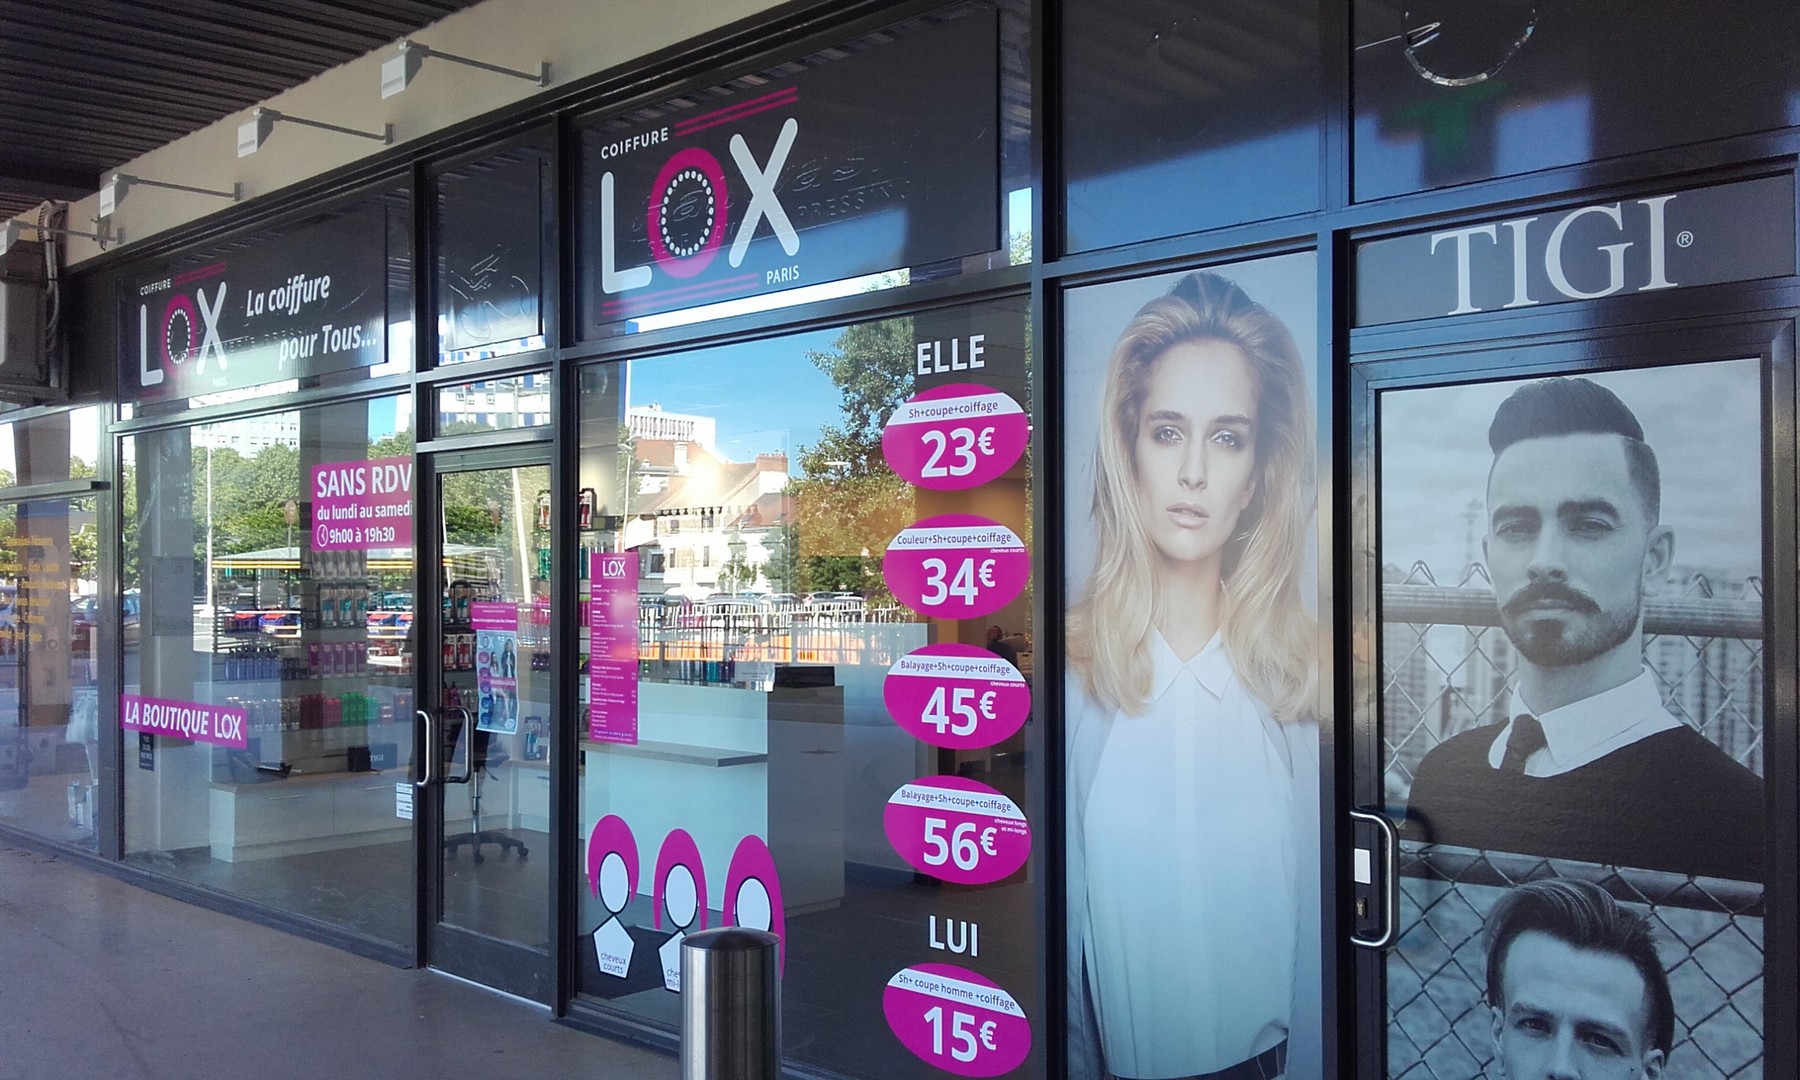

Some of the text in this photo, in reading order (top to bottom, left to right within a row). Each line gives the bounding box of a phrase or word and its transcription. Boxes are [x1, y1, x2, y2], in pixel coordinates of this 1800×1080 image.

[600, 127, 669, 160] COIFFURE
[600, 117, 800, 294] LOX
[139, 278, 172, 296] COIFFURE
[766, 265, 800, 286] PARIS
[246, 274, 331, 317] La coiffure
[140, 281, 228, 387] LOX
[278, 331, 318, 370] pour
[322, 323, 377, 353] Tous...
[917, 334, 985, 376] ELLE
[908, 401, 999, 419] Sh+coupe+coiffage
[920, 426, 996, 478] 23€
[316, 463, 412, 498] SANS RDV
[317, 500, 413, 520] du lundi au samedi
[329, 526, 395, 544] 9h00 à 19h30
[897, 532, 1012, 546] Couleur+Sh+coupe+coiffage
[602, 560, 626, 576] LOX
[921, 557, 996, 606] 34€
[900, 660, 1011, 676] Balayage+Sh+coupe+coiffage
[124, 700, 242, 741] LA BOUTIQUE LOX
[921, 686, 997, 737] 45€
[923, 817, 998, 871] 56€
[929, 915, 978, 957] LUI
[600, 952, 627, 966] cheveux
[603, 961, 624, 974] courts
[898, 974, 1015, 1010] Sh+ coupe homme +coiffage
[924, 1006, 998, 1063] 15€
